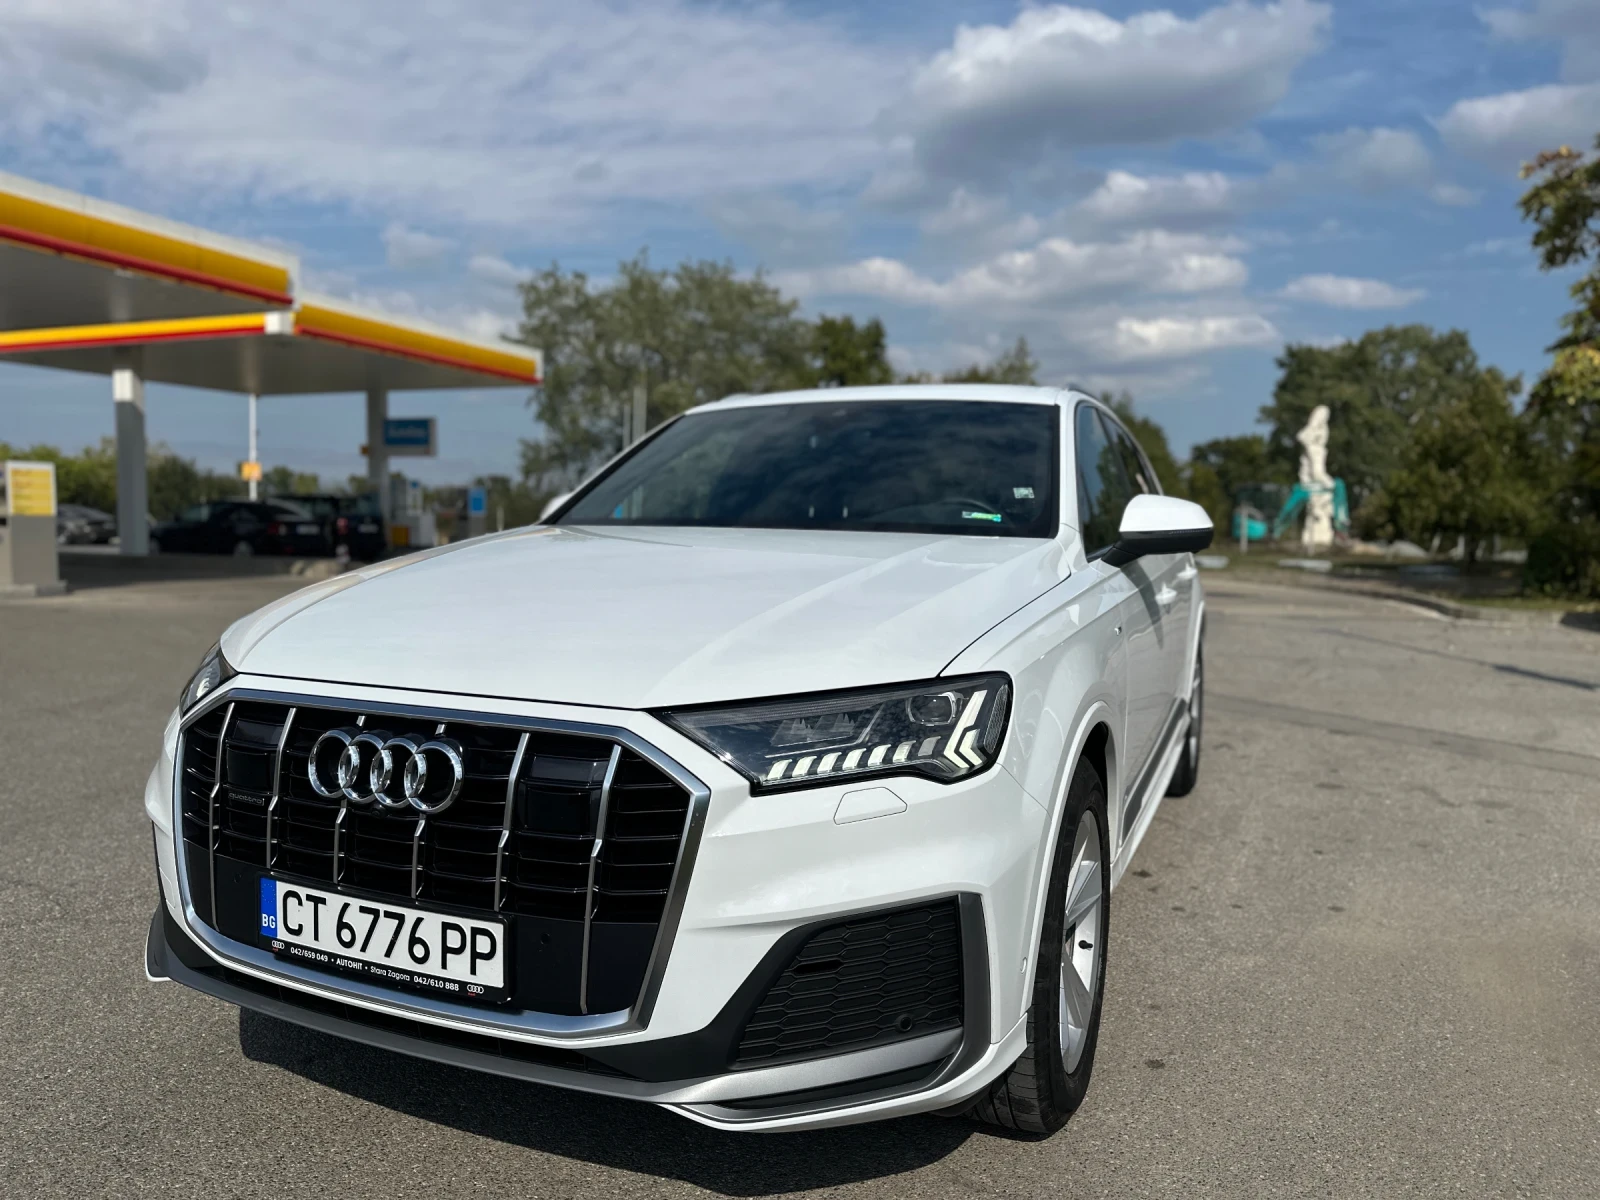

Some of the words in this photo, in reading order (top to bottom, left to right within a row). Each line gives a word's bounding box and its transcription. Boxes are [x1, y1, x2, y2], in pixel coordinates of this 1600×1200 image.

[262, 913, 276, 929] BG
[282, 889, 327, 942] CT
[335, 902, 431, 965] 6776
[440, 921, 497, 976] PP
[290, 946, 315, 959] 042/659
[316, 953, 328, 962] 049
[336, 957, 363, 970] AUTOHIT
[370, 965, 387, 976] Stara
[387, 969, 410, 981] Zagora
[413, 975, 444, 988] 042/610
[445, 982, 459, 992] 888
